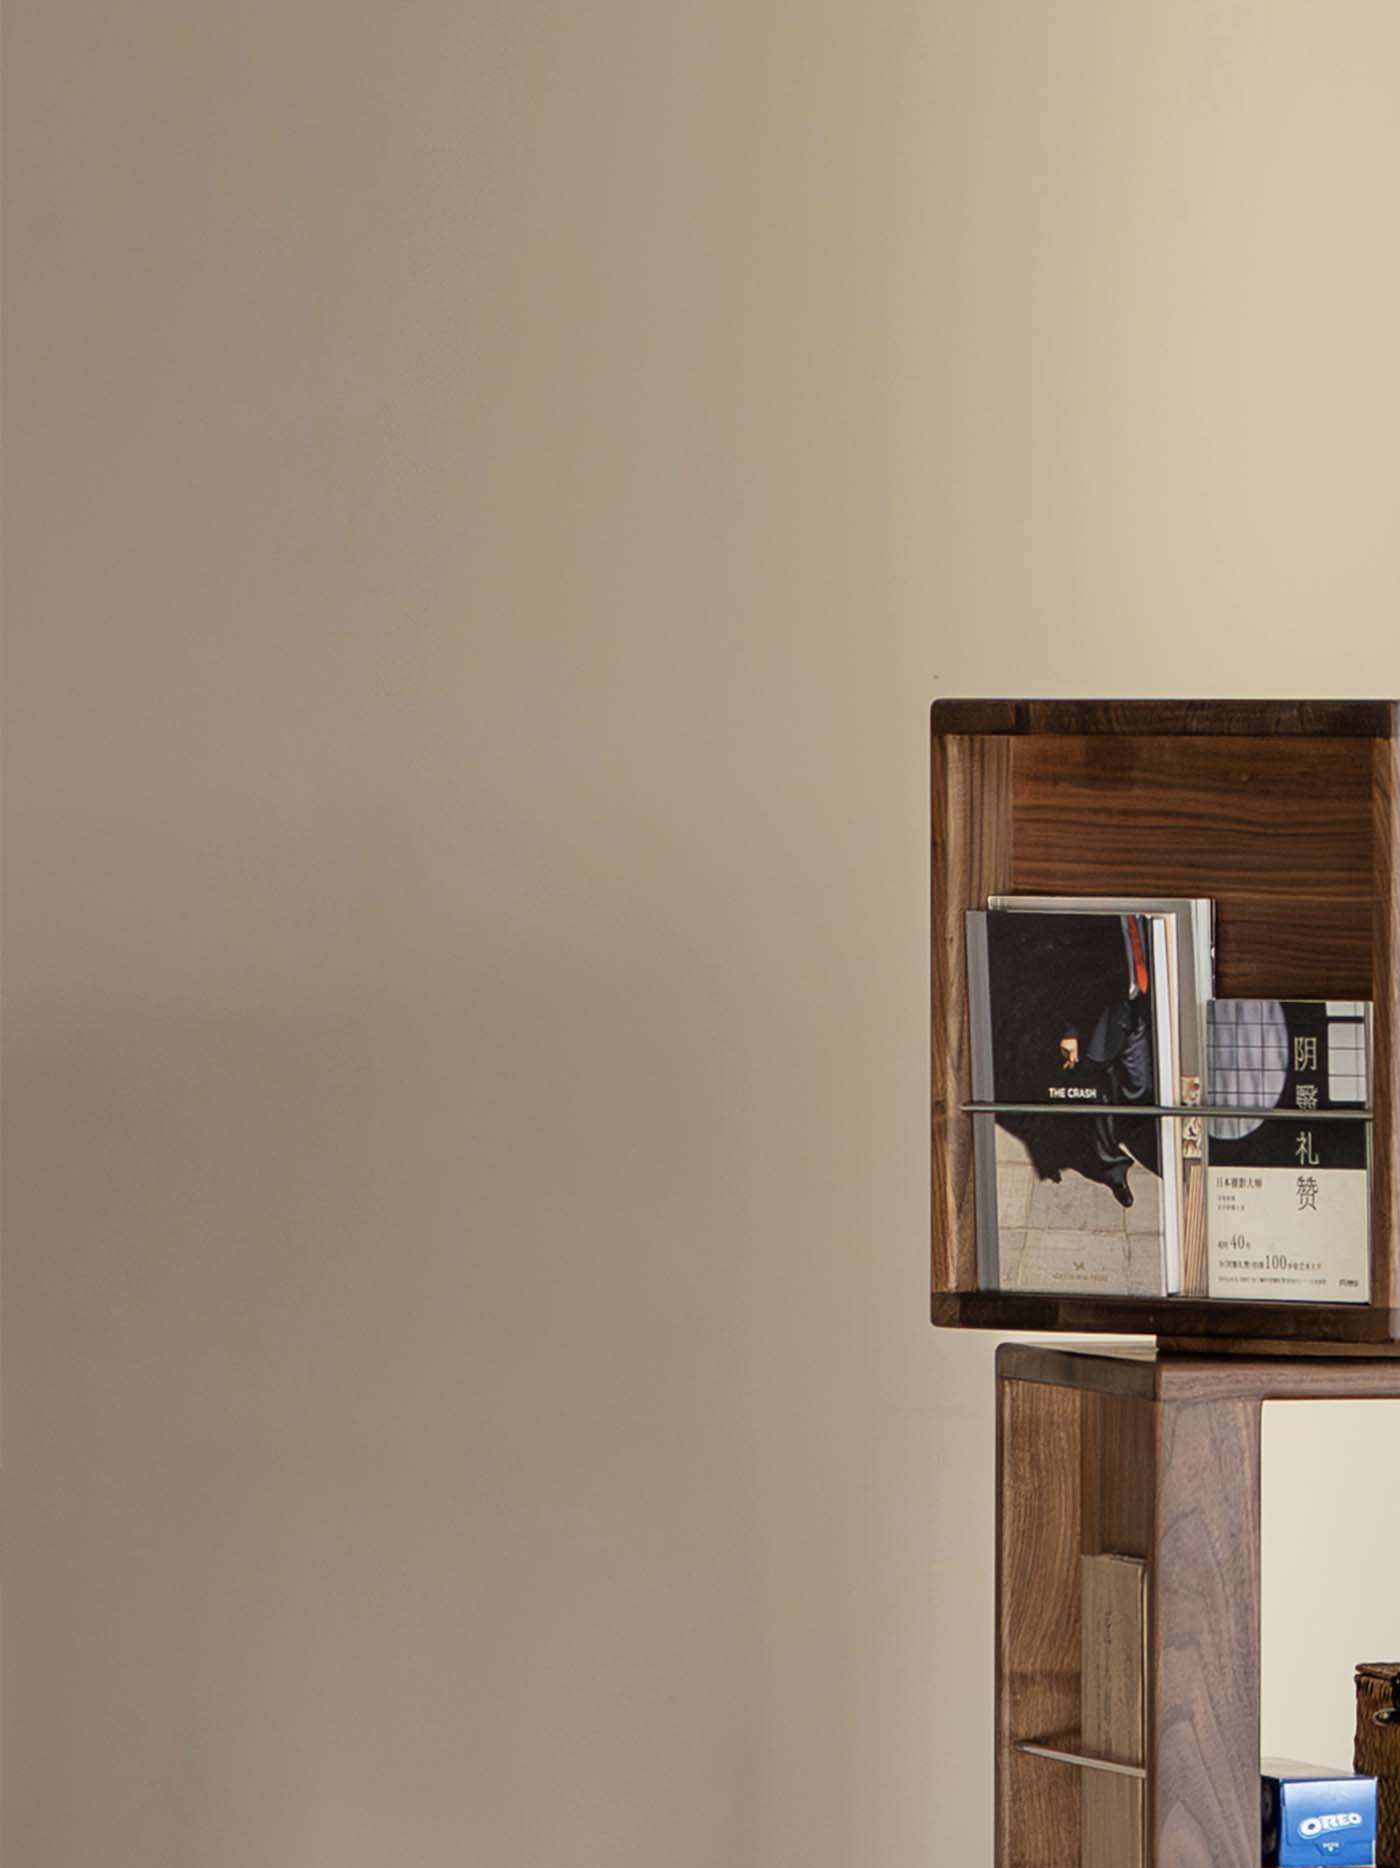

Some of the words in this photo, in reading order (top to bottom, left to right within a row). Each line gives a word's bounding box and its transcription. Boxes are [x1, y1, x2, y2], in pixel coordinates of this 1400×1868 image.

[1048, 1087, 1066, 1099] THE
[1067, 1087, 1098, 1099] CRASH
[1299, 1812, 1363, 1838] OREO
